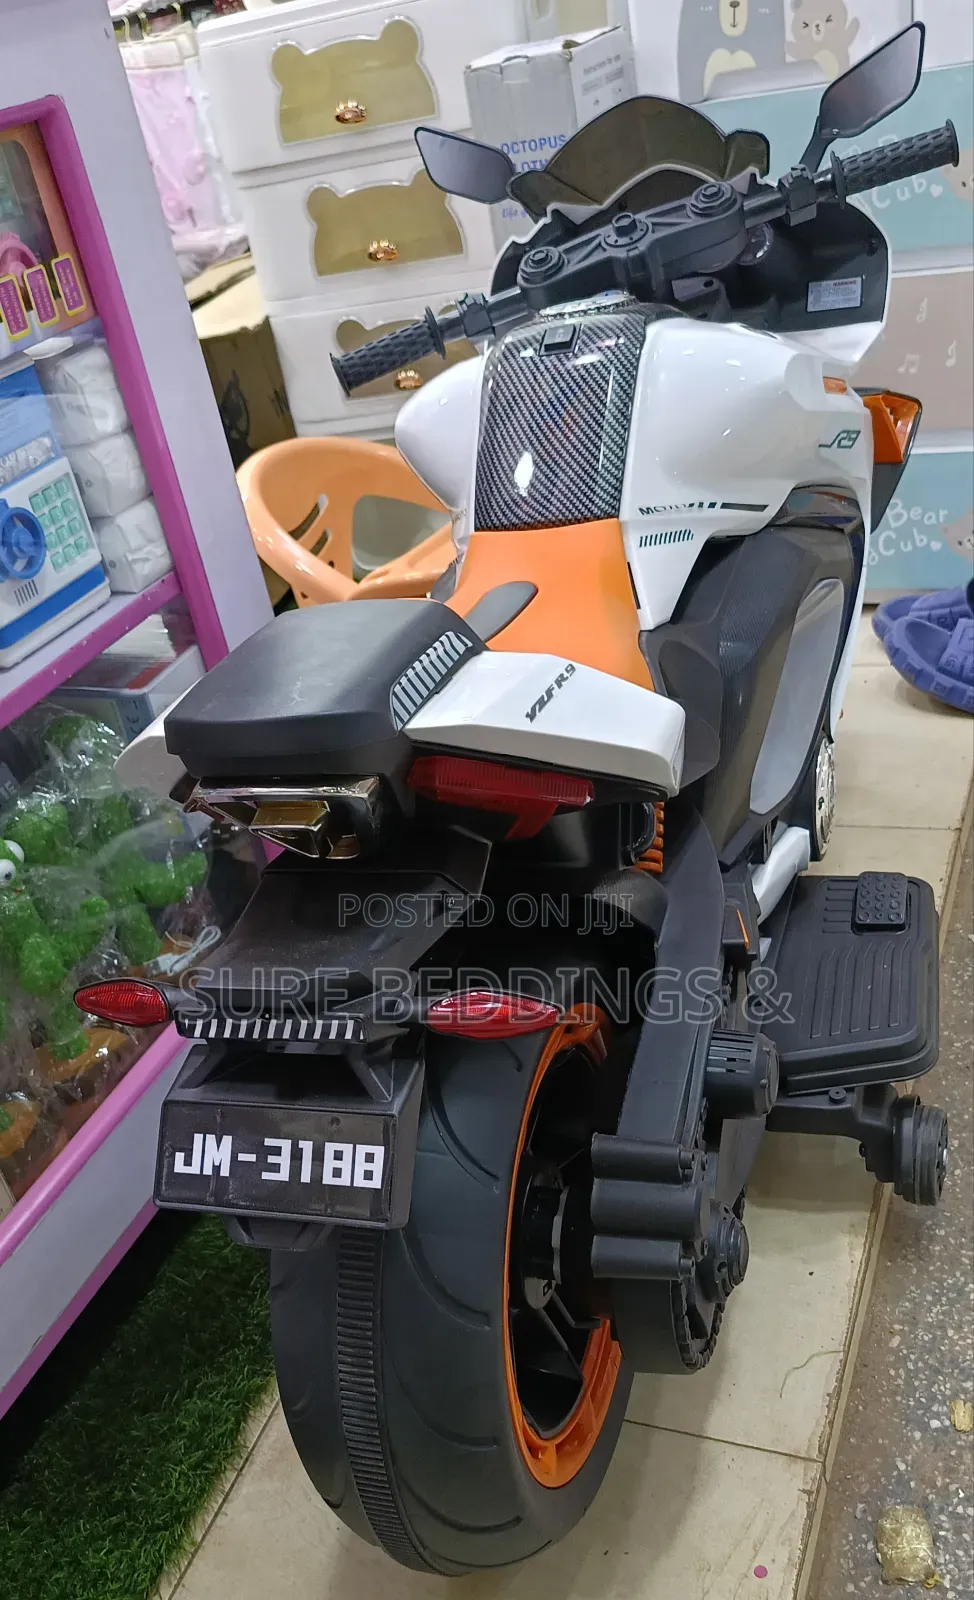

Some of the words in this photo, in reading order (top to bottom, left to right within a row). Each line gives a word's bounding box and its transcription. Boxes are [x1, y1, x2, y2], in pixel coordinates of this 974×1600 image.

[501, 134, 567, 155] OCTOPUS
[886, 498, 948, 529] Bear
[878, 527, 928, 556] Cub
[173, 1132, 386, 1190] JM-3188
